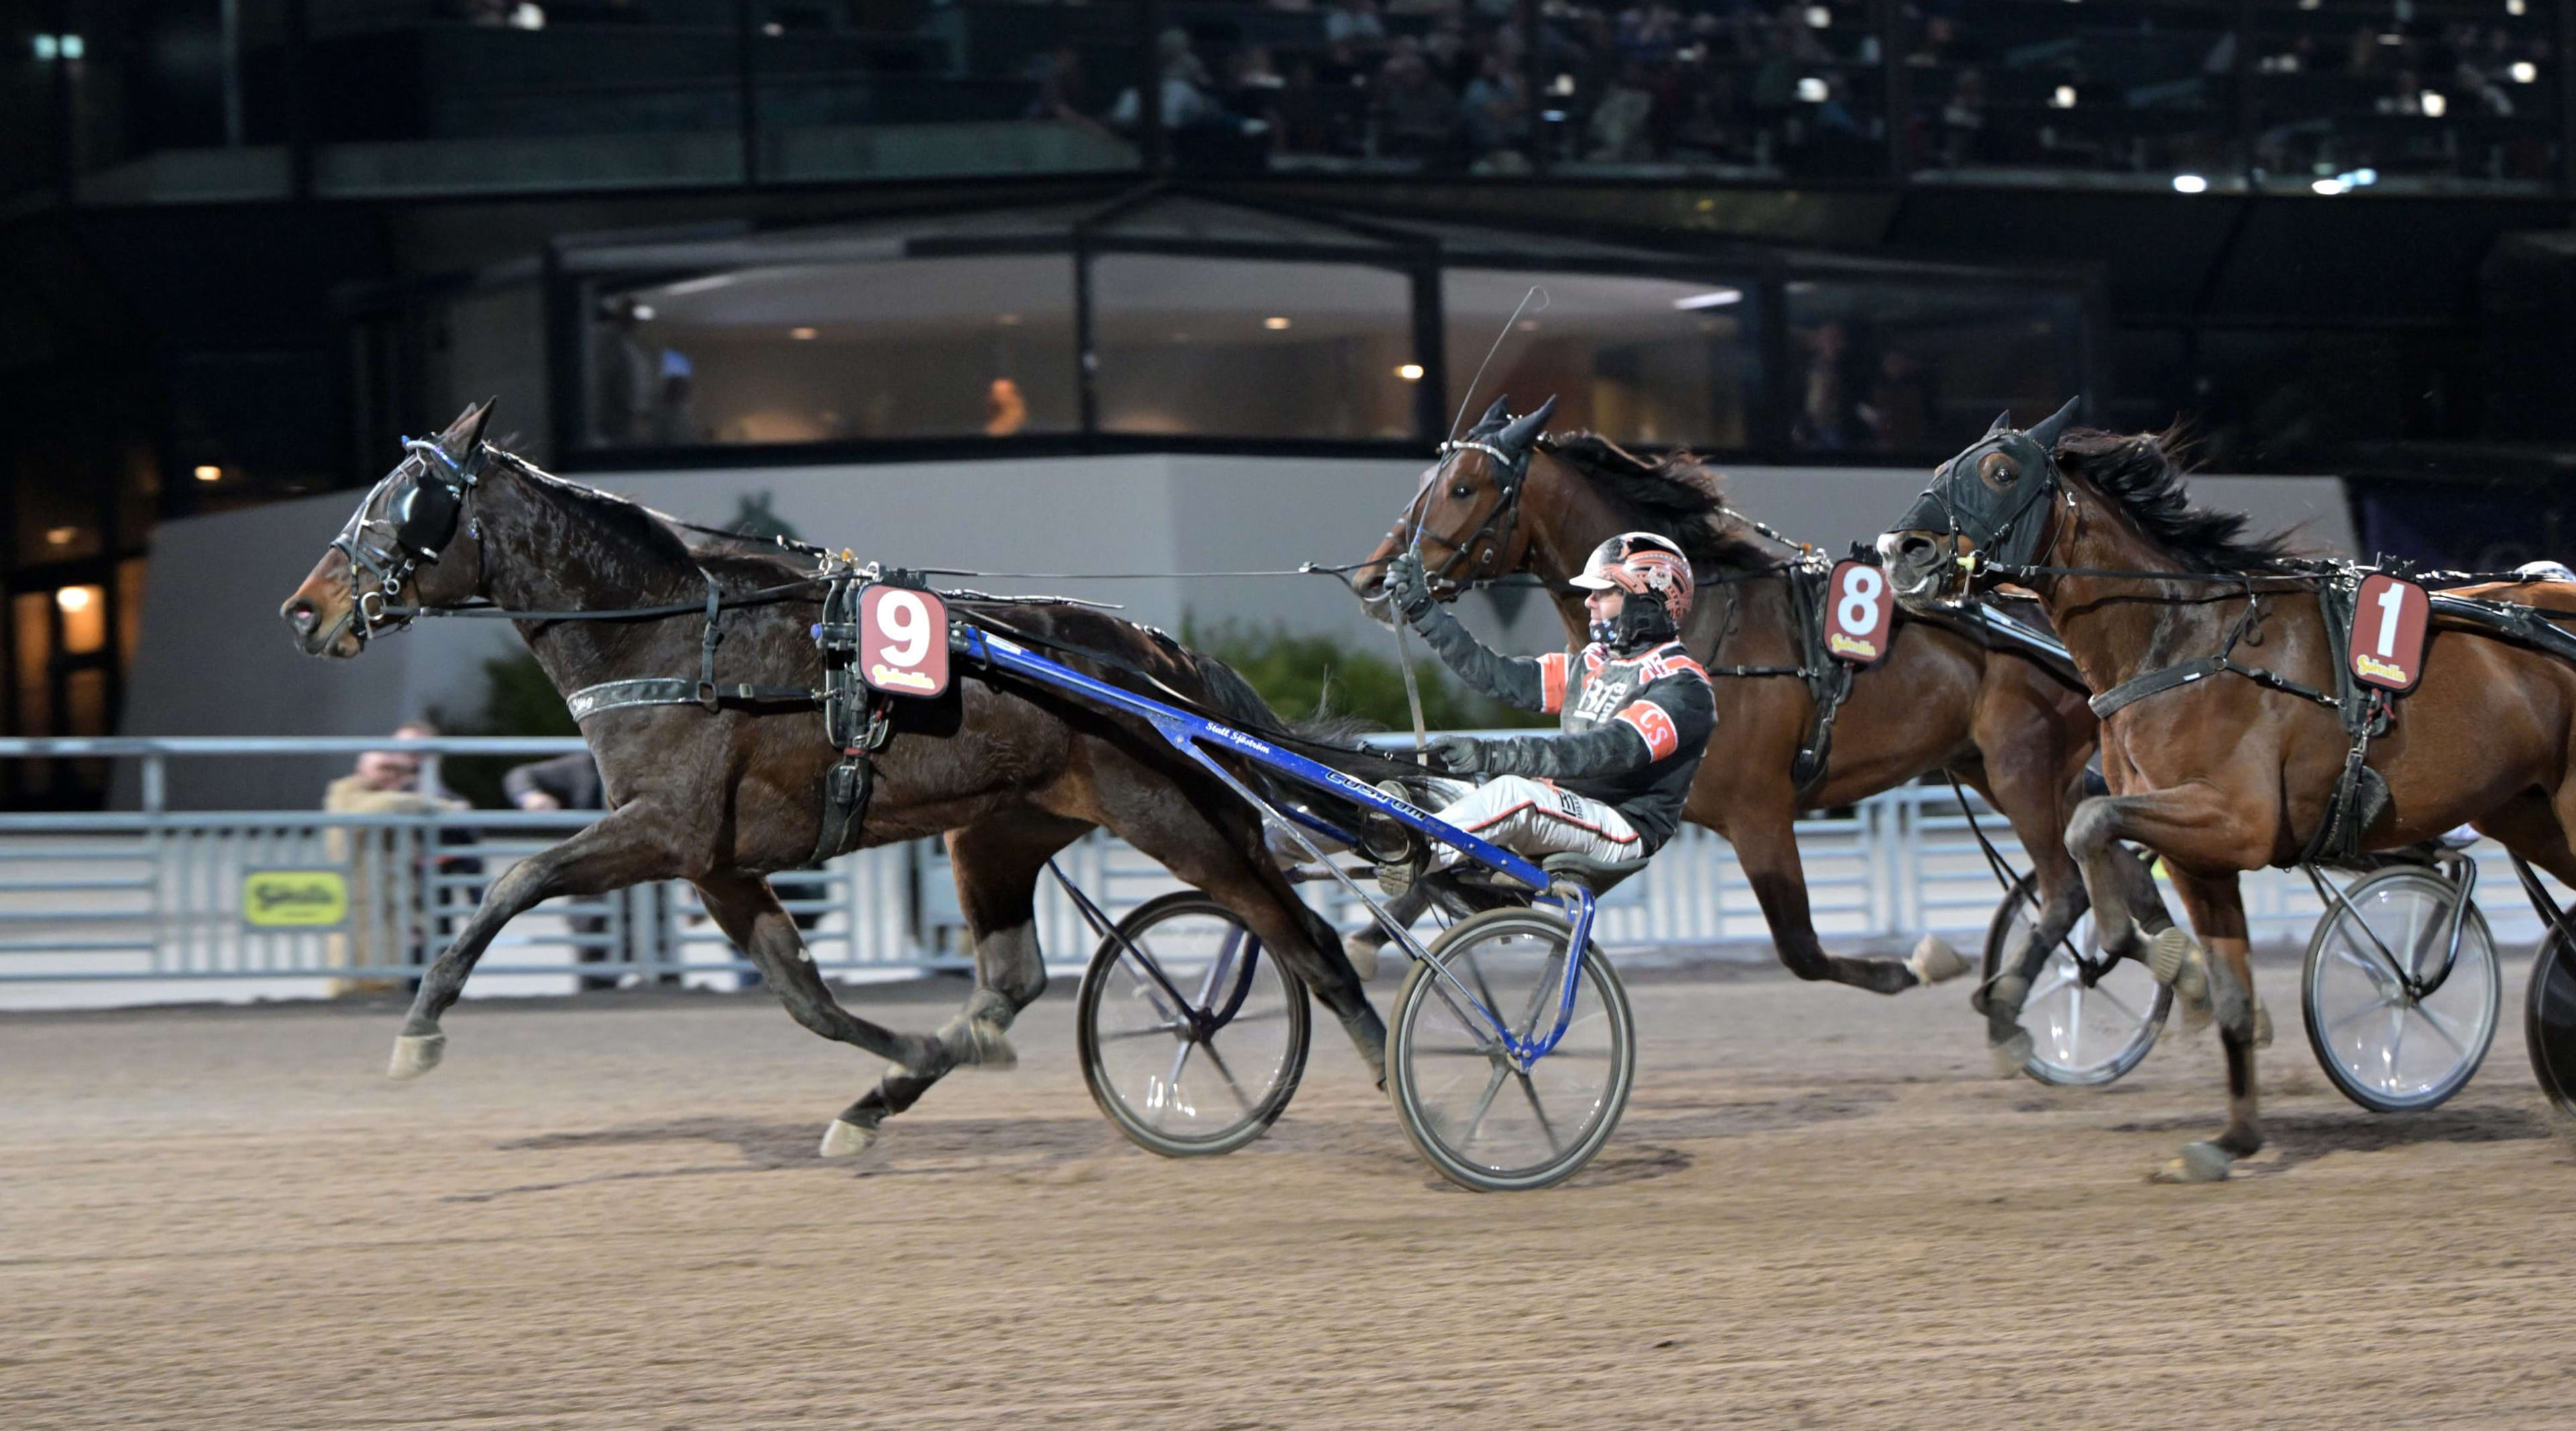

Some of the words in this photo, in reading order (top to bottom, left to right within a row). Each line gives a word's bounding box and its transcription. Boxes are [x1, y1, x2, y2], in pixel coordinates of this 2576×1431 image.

[876, 590, 930, 668] 9
[1837, 565, 1882, 636] 8
[2377, 582, 2405, 657] 1
[1205, 722, 1230, 737] Stall
[1640, 708, 1668, 746] CS
